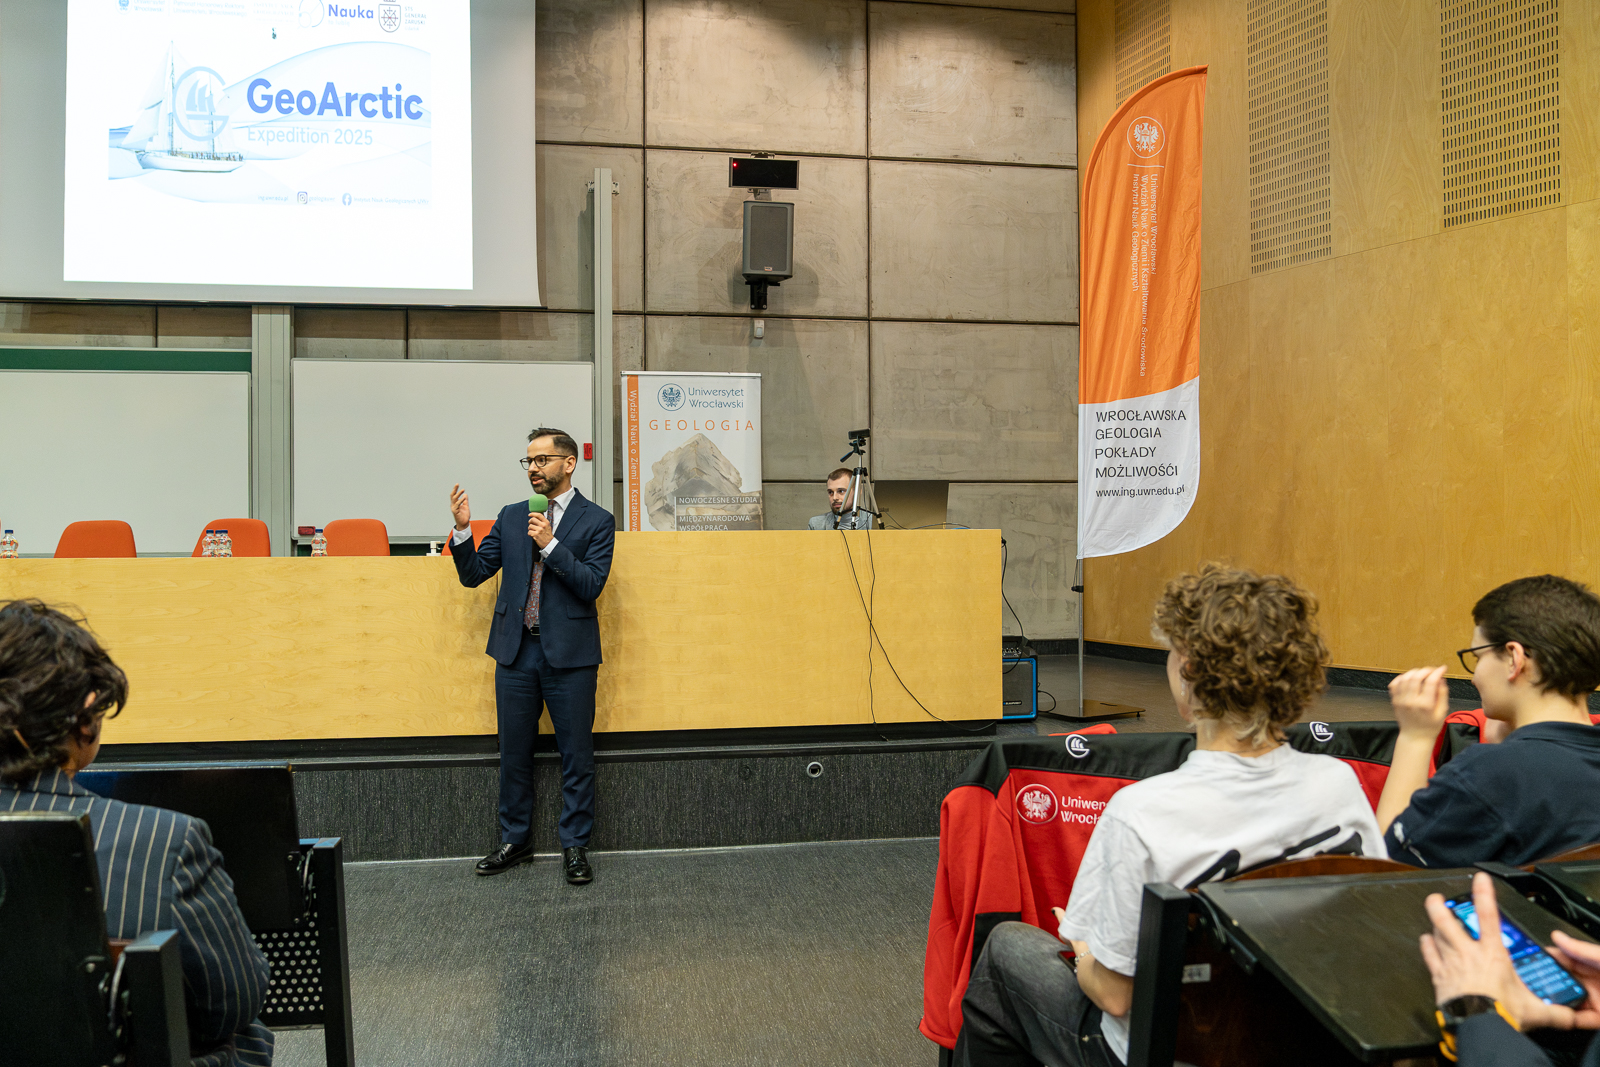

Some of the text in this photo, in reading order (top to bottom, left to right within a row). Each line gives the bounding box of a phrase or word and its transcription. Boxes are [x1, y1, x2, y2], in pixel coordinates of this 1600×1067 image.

[328, 4, 374, 19] Nauka
[247, 77, 423, 121] GeoArctic
[247, 127, 373, 146] Expedition 2025
[1140, 174, 1149, 207] Wydział
[1141, 208, 1149, 230] Nauk
[1149, 173, 1158, 275] Uniwersytet Wrocławski
[1130, 173, 1140, 292] Instytut Nauk Geologicznych
[1141, 238, 1150, 262] Ziemi
[1140, 326, 1148, 377] Środowiska
[688, 387, 744, 398] Uniwersytet
[628, 389, 638, 422] Wydział
[689, 399, 744, 409] Wrocławski
[649, 419, 755, 431] GEOLOGIA
[1096, 409, 1187, 423] WROCŁAWSKA
[630, 424, 638, 446] Nauk
[1095, 427, 1162, 440] GEOLOGIA
[1095, 446, 1157, 460] POKŁADY
[631, 457, 639, 480] Ziemi
[1096, 484, 1185, 498] www.ing.uwr.edu.pl
[680, 515, 751, 523] MIĘDZYNARODOWA
[1061, 796, 1108, 811] Uniwer
